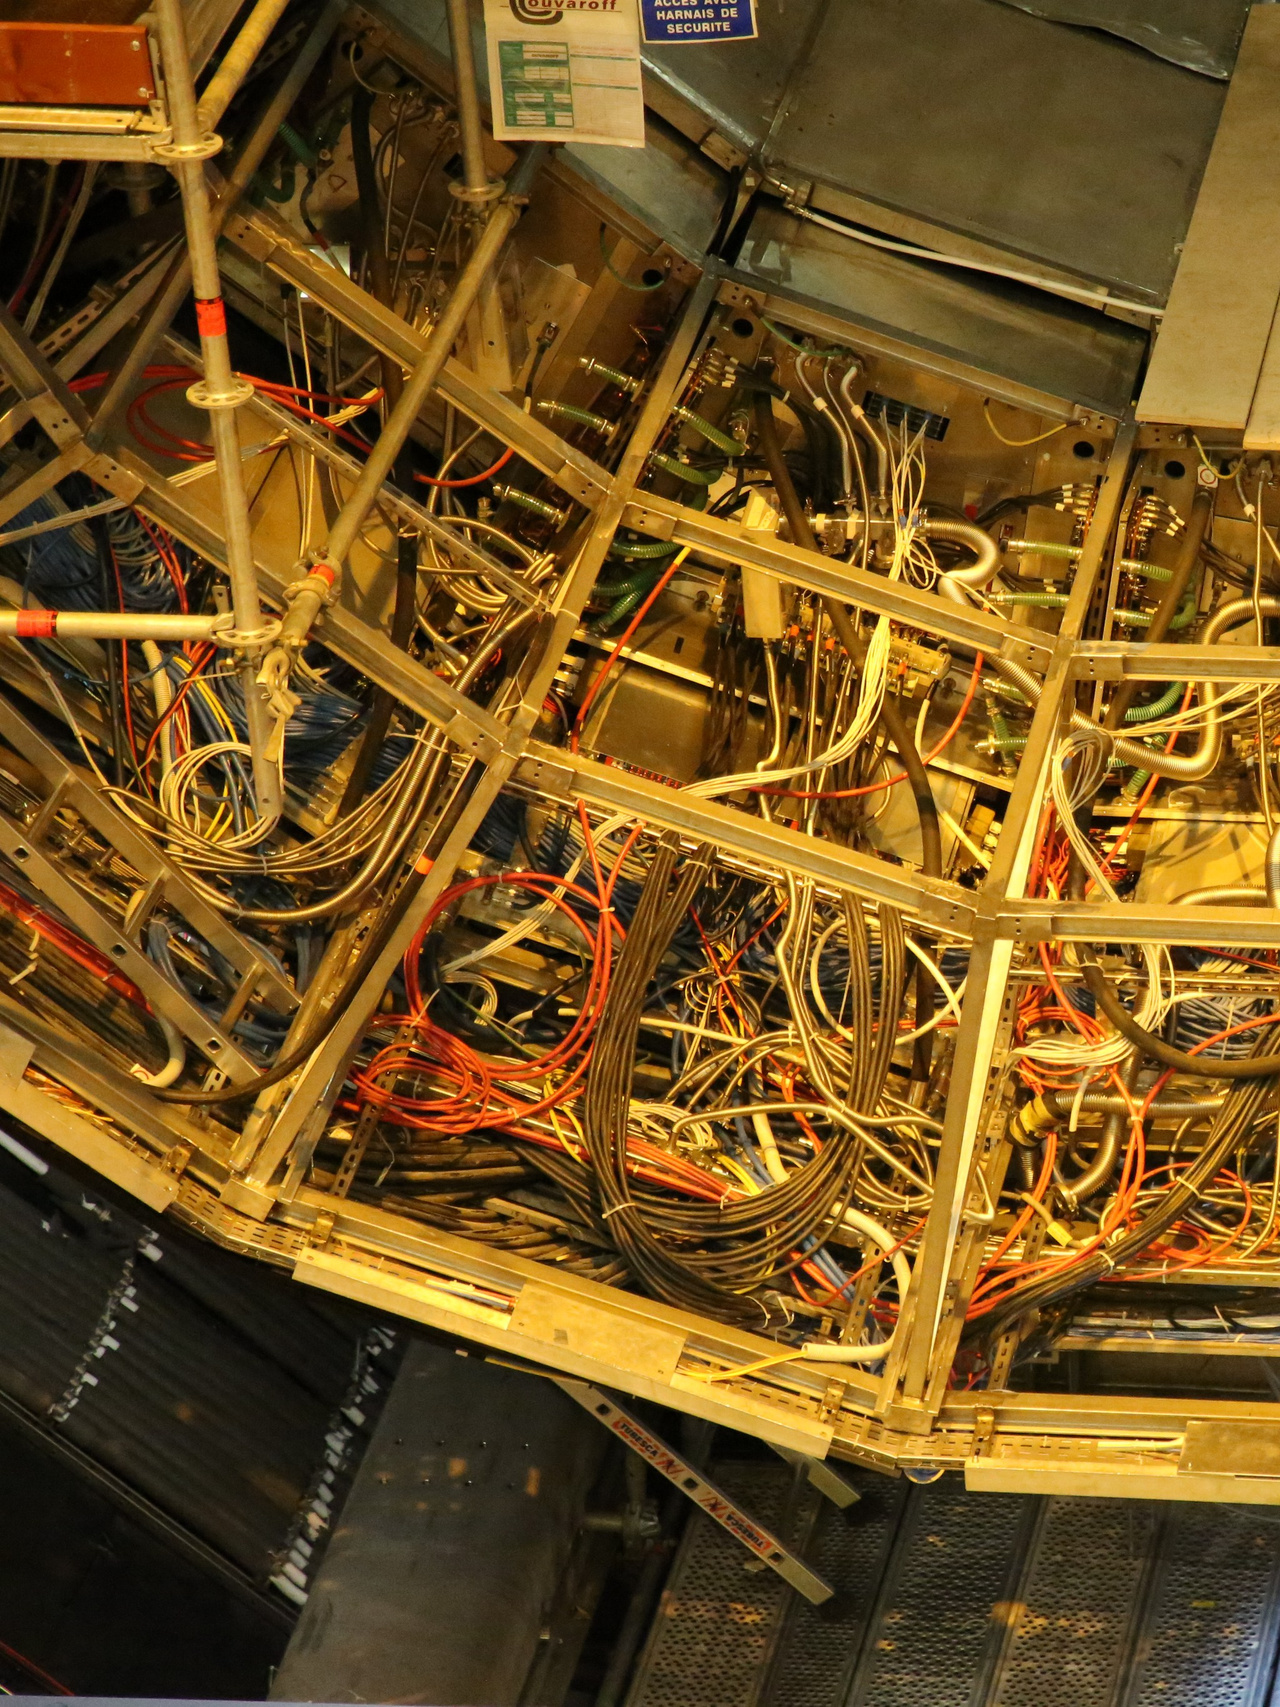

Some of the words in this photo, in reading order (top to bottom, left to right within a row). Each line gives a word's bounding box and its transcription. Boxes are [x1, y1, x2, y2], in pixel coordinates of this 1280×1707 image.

[656, 9, 714, 20] HARNAIS
[721, 8, 738, 18] DE
[667, 22, 731, 33] SECURITE
